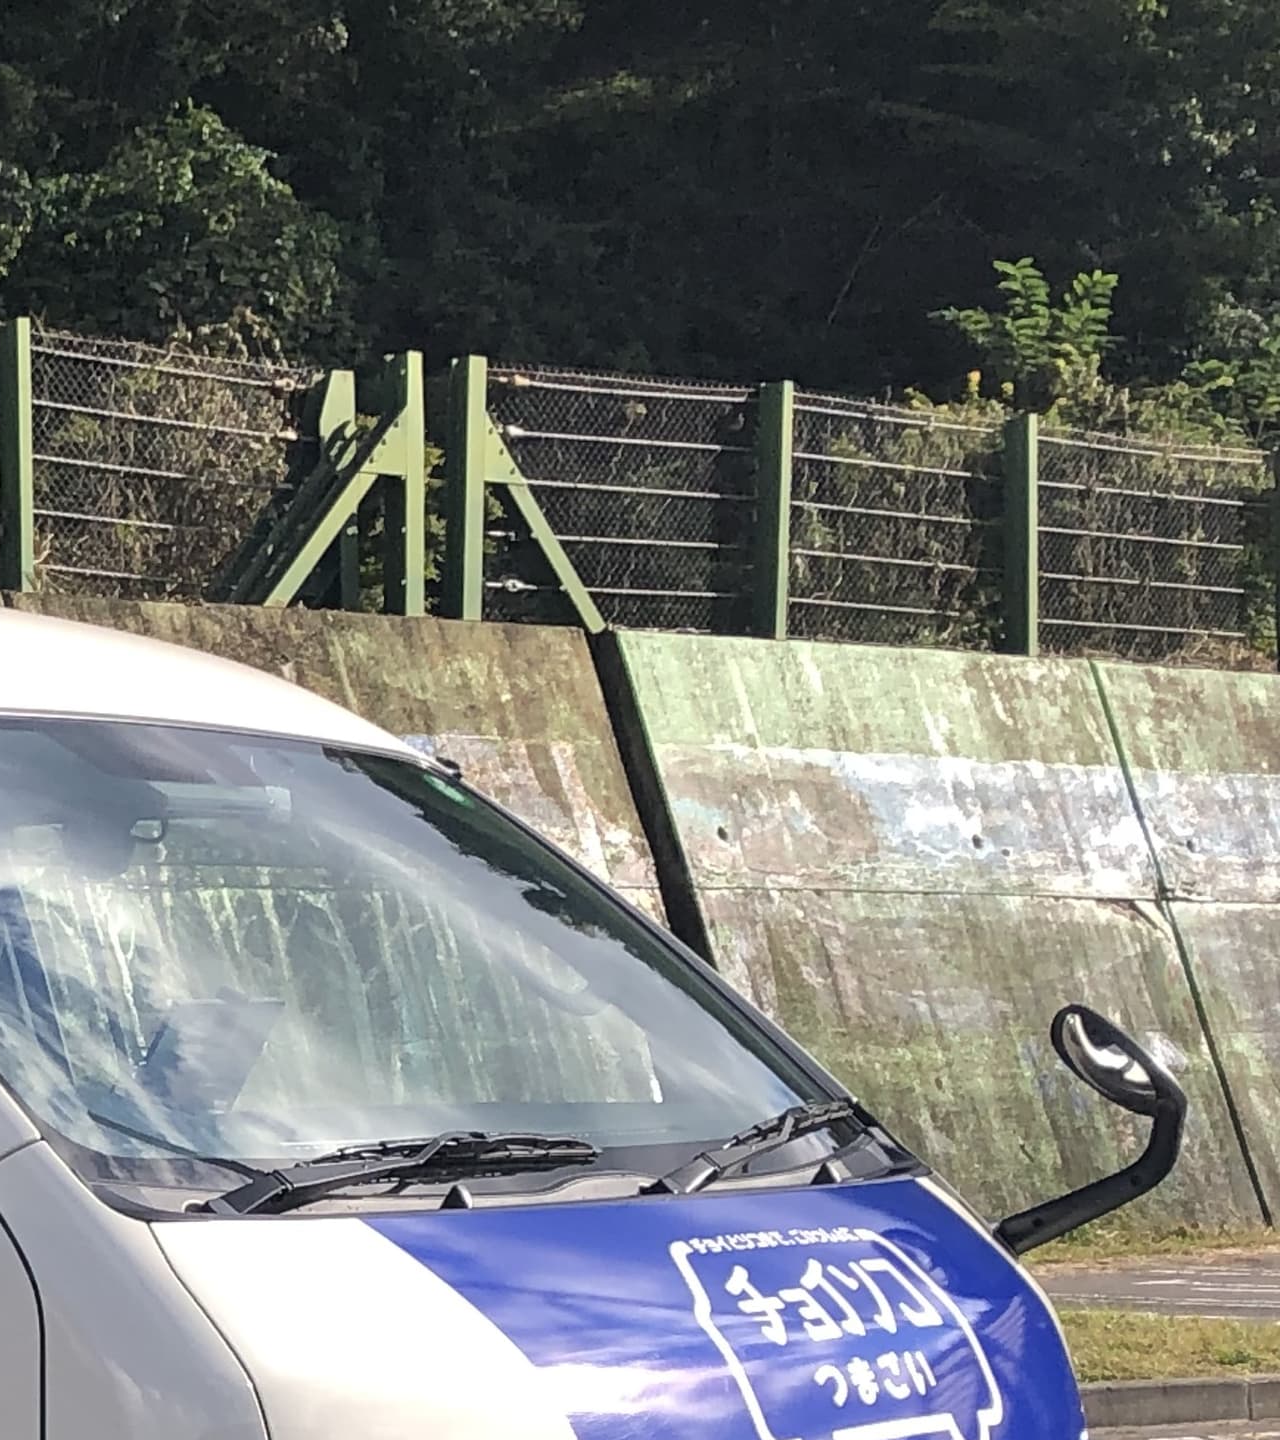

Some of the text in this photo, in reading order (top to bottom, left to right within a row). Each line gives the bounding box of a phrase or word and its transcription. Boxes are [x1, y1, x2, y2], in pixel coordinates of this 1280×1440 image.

[724, 1257, 944, 1346] チョイソコ
